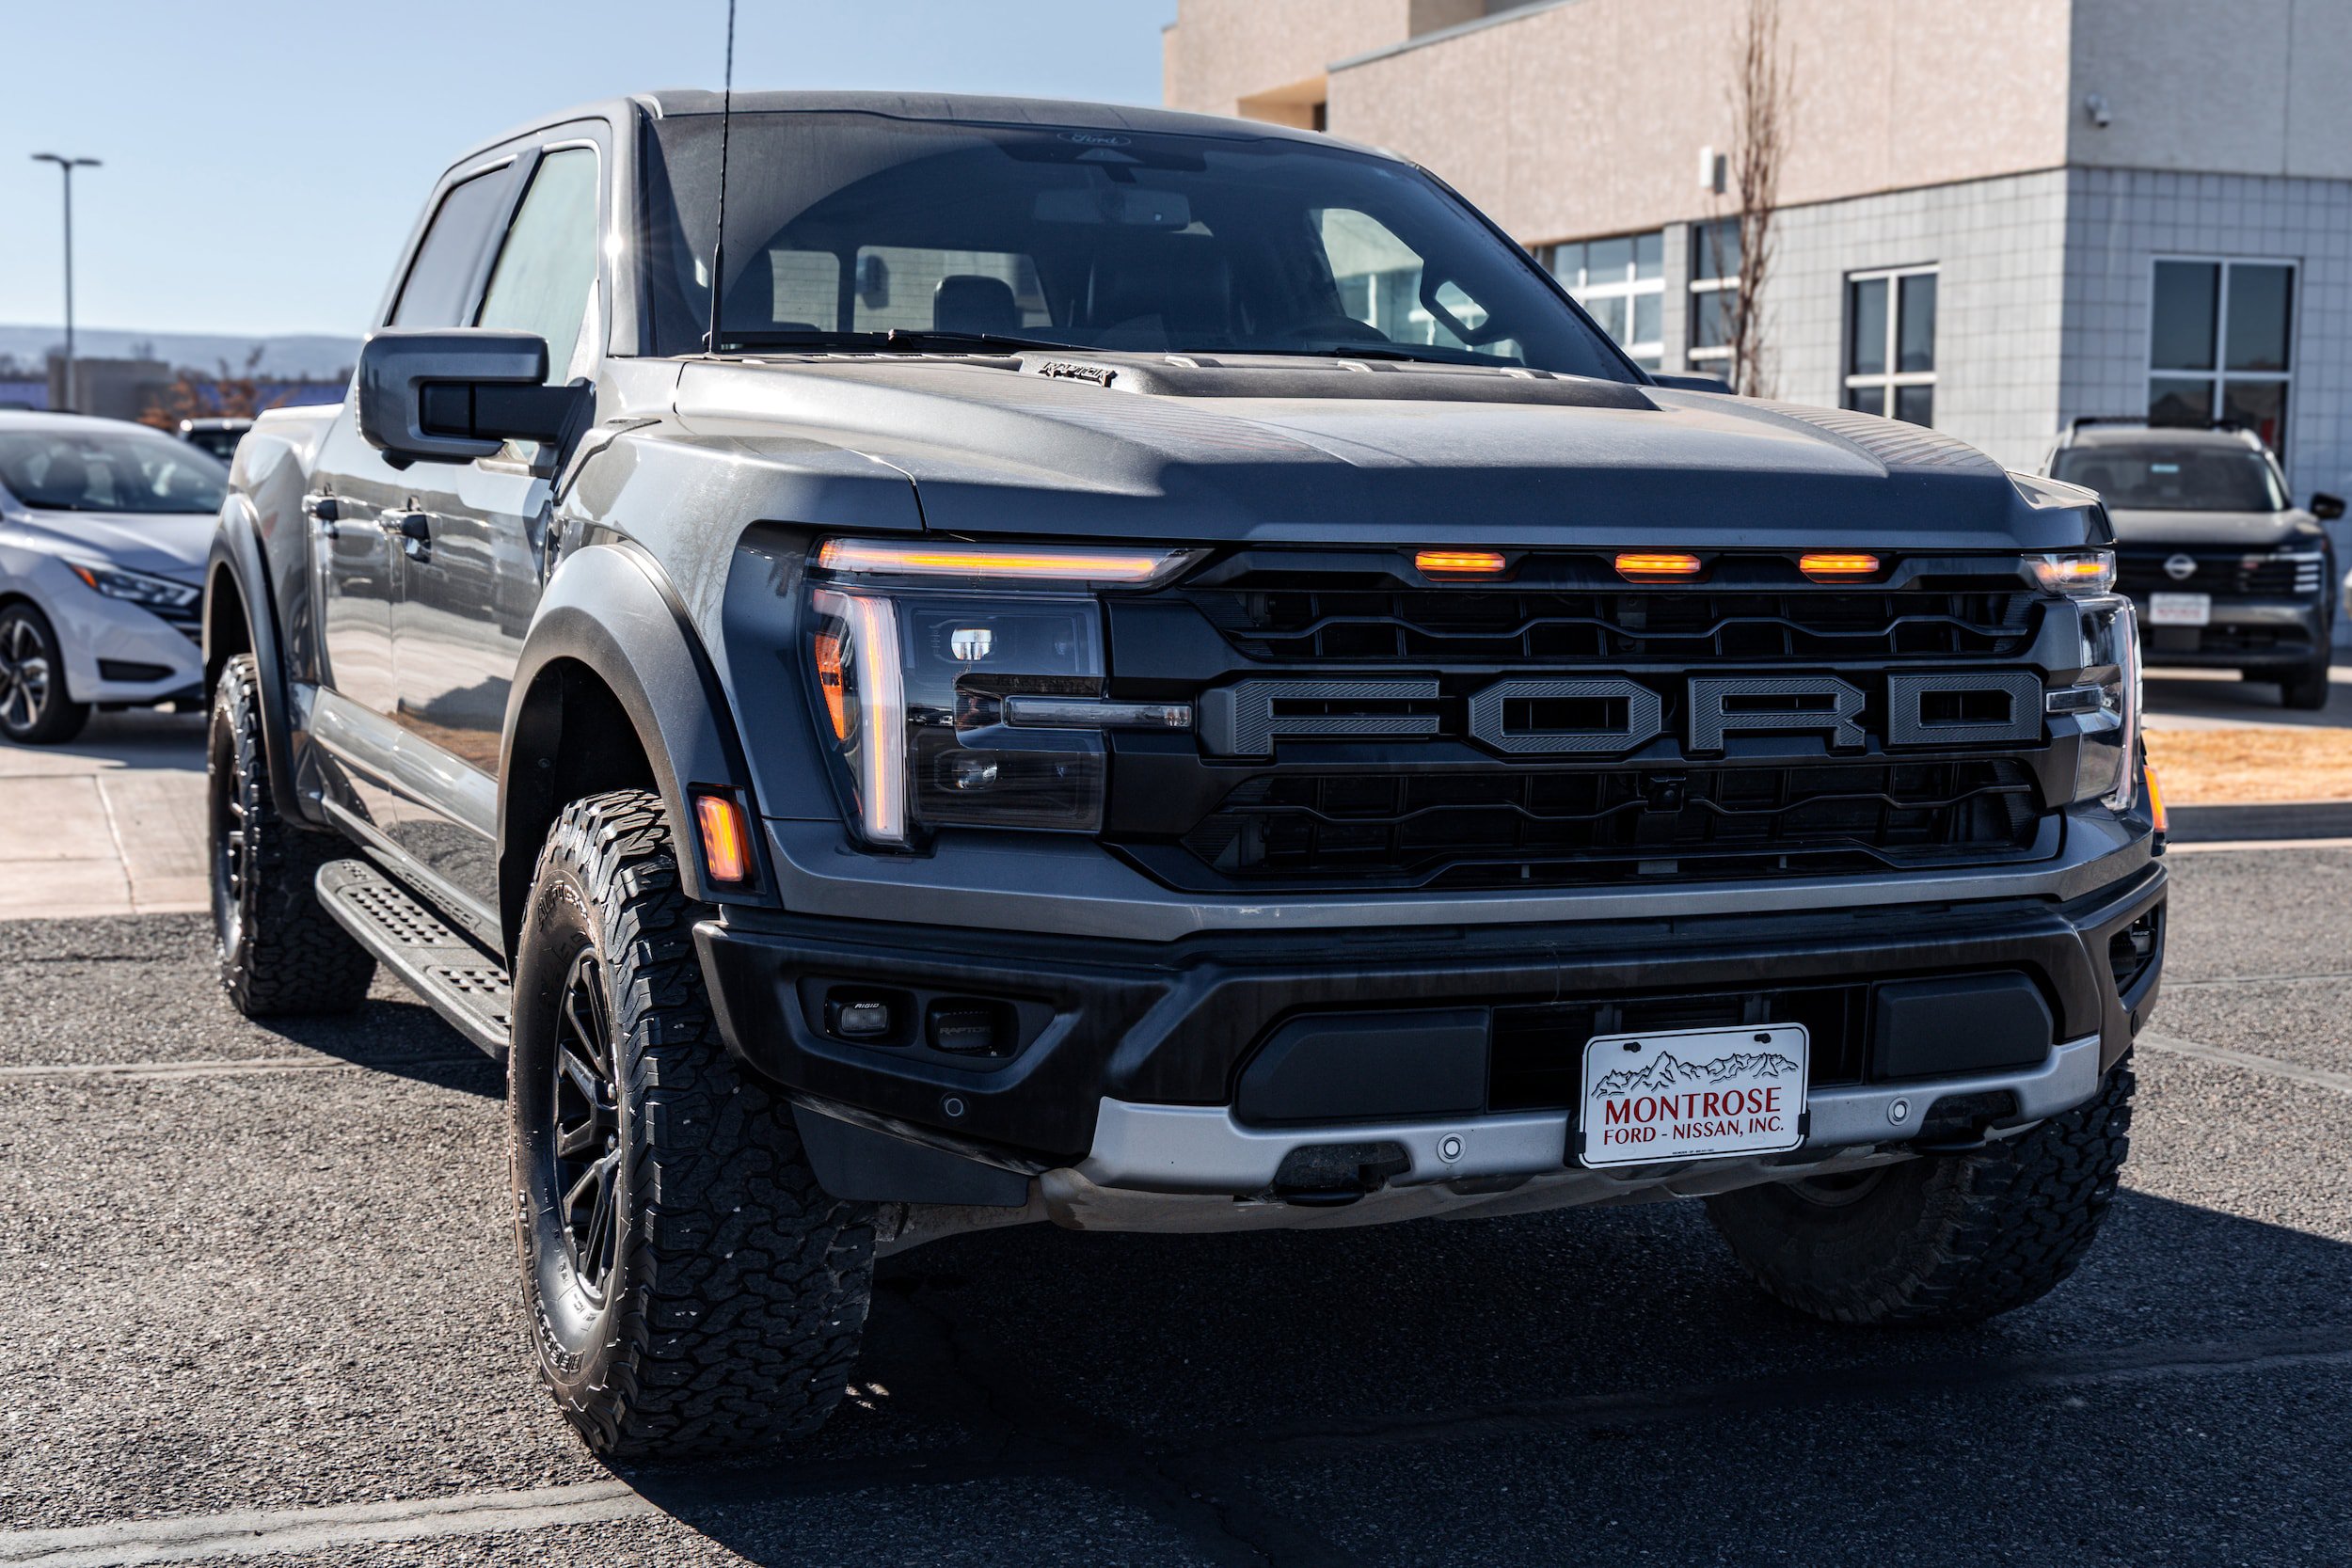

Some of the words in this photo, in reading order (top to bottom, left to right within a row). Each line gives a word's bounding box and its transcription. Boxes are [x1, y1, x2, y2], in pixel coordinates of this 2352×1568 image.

[1072, 133, 1119, 144] Ford
[1039, 361, 1118, 388] RAPTOR
[1233, 673, 2042, 755] FORD
[1604, 1086, 1782, 1126] MONTROSE
[1603, 1126, 1656, 1146] FORD
[1673, 1119, 1743, 1140] NISSAN,
[1749, 1116, 1784, 1134] INC.
